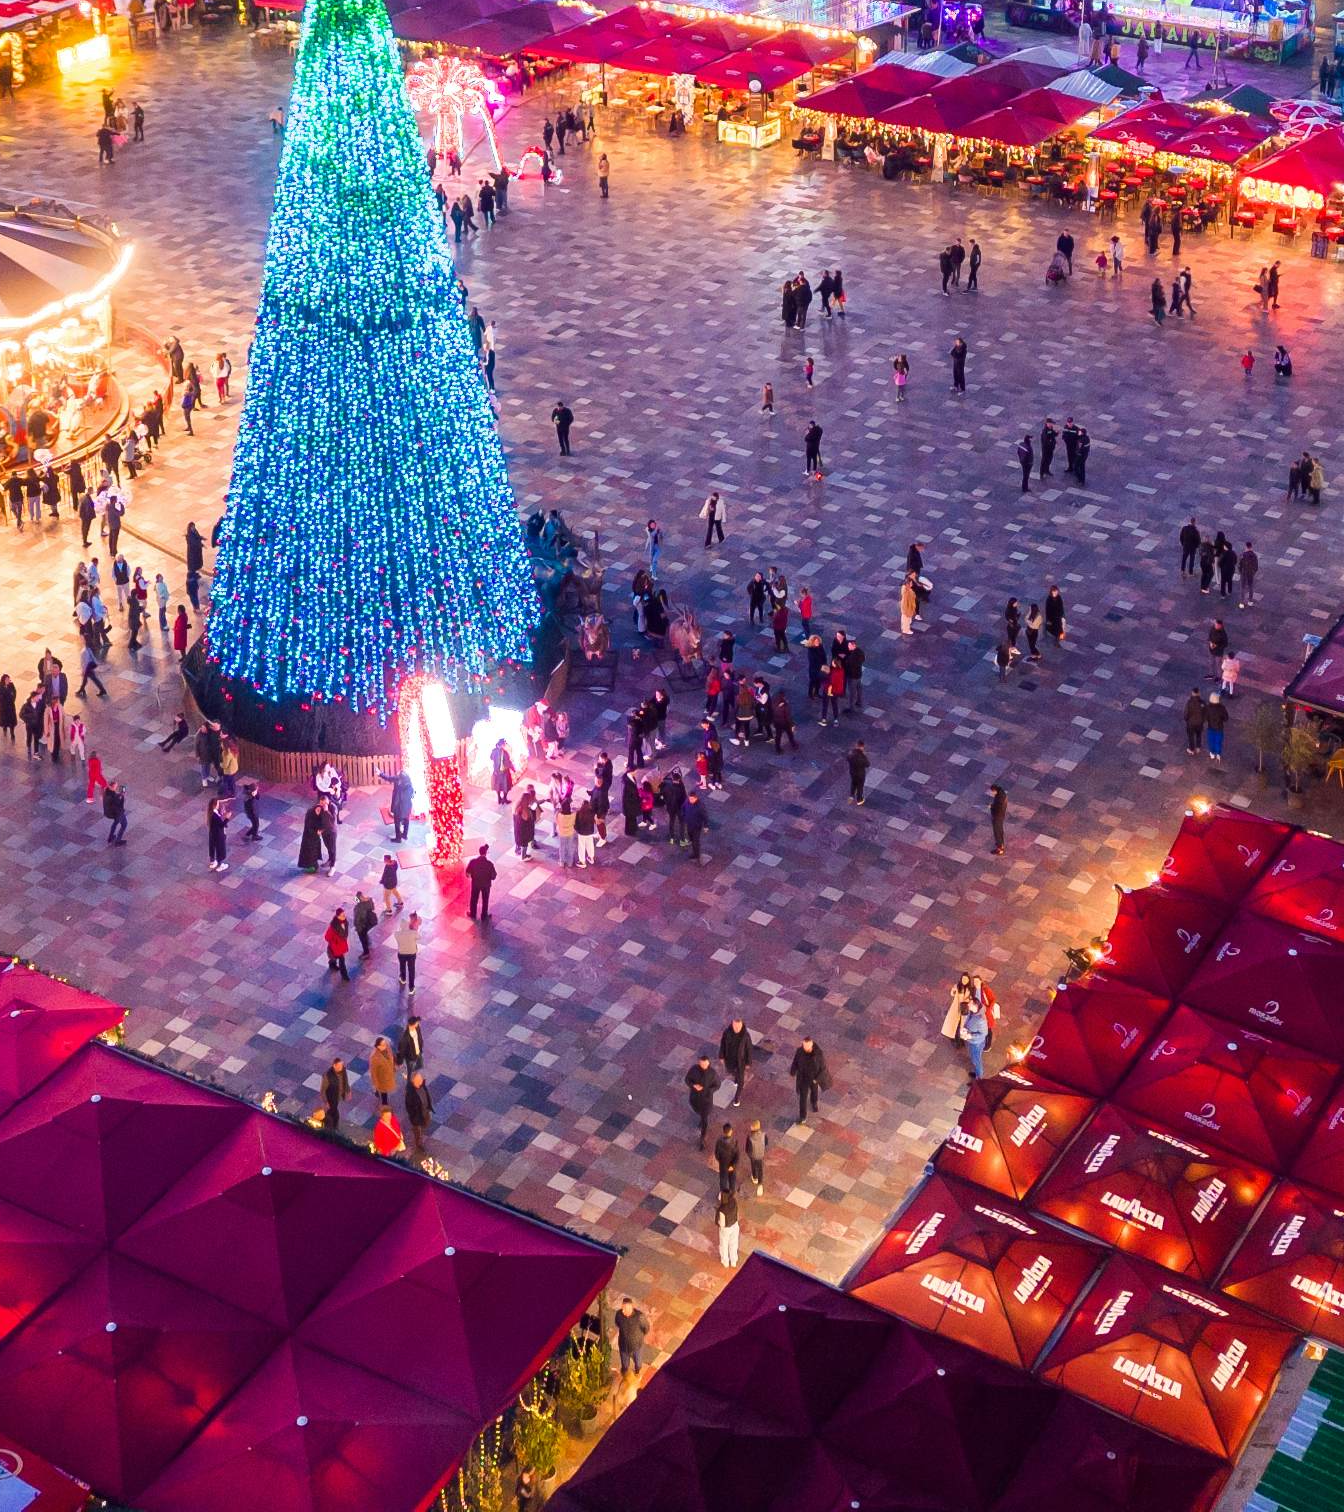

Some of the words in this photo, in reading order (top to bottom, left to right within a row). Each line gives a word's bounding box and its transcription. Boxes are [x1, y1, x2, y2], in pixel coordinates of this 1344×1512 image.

[1010, 1104, 1046, 1147] LAVAZZA
[1101, 1192, 1164, 1230] LAVAZZA
[1191, 1178, 1226, 1223] LAVAZZA
[920, 1273, 985, 1314] LAVAZZA
[1013, 1255, 1052, 1304] LAVAZZA
[1113, 1356, 1182, 1399] LAVAZZA
[1211, 1338, 1247, 1391] LAVAZZA
